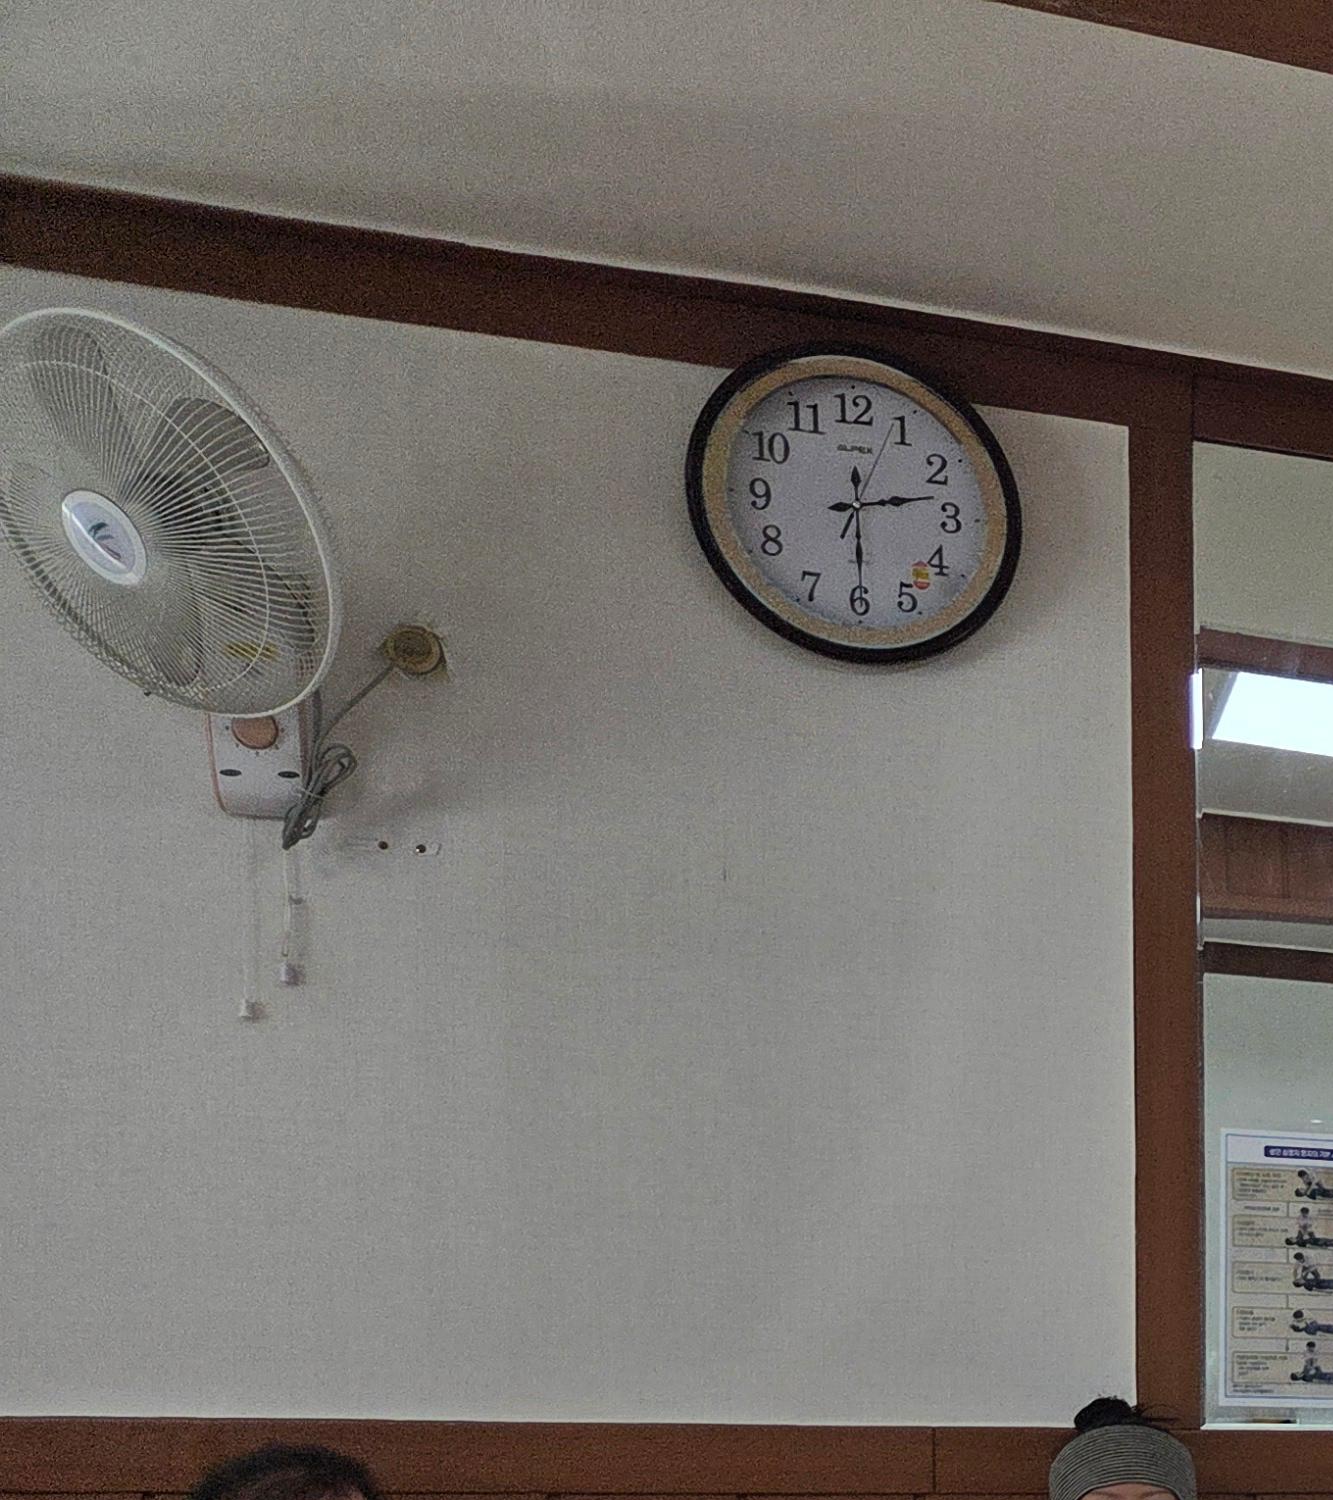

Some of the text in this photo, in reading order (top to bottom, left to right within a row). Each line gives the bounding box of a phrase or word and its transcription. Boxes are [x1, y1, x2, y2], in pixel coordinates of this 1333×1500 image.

[786, 401, 825, 434] 11
[833, 393, 874, 426] 12
[893, 415, 912, 447] 1
[751, 431, 790, 464] 10
[925, 453, 948, 485] 2
[749, 477, 772, 510] 9
[939, 502, 962, 534] 3
[760, 524, 783, 556] 8
[927, 544, 950, 577] 4
[801, 570, 821, 602] 7
[849, 585, 870, 616] 6
[897, 582, 918, 613] 5
